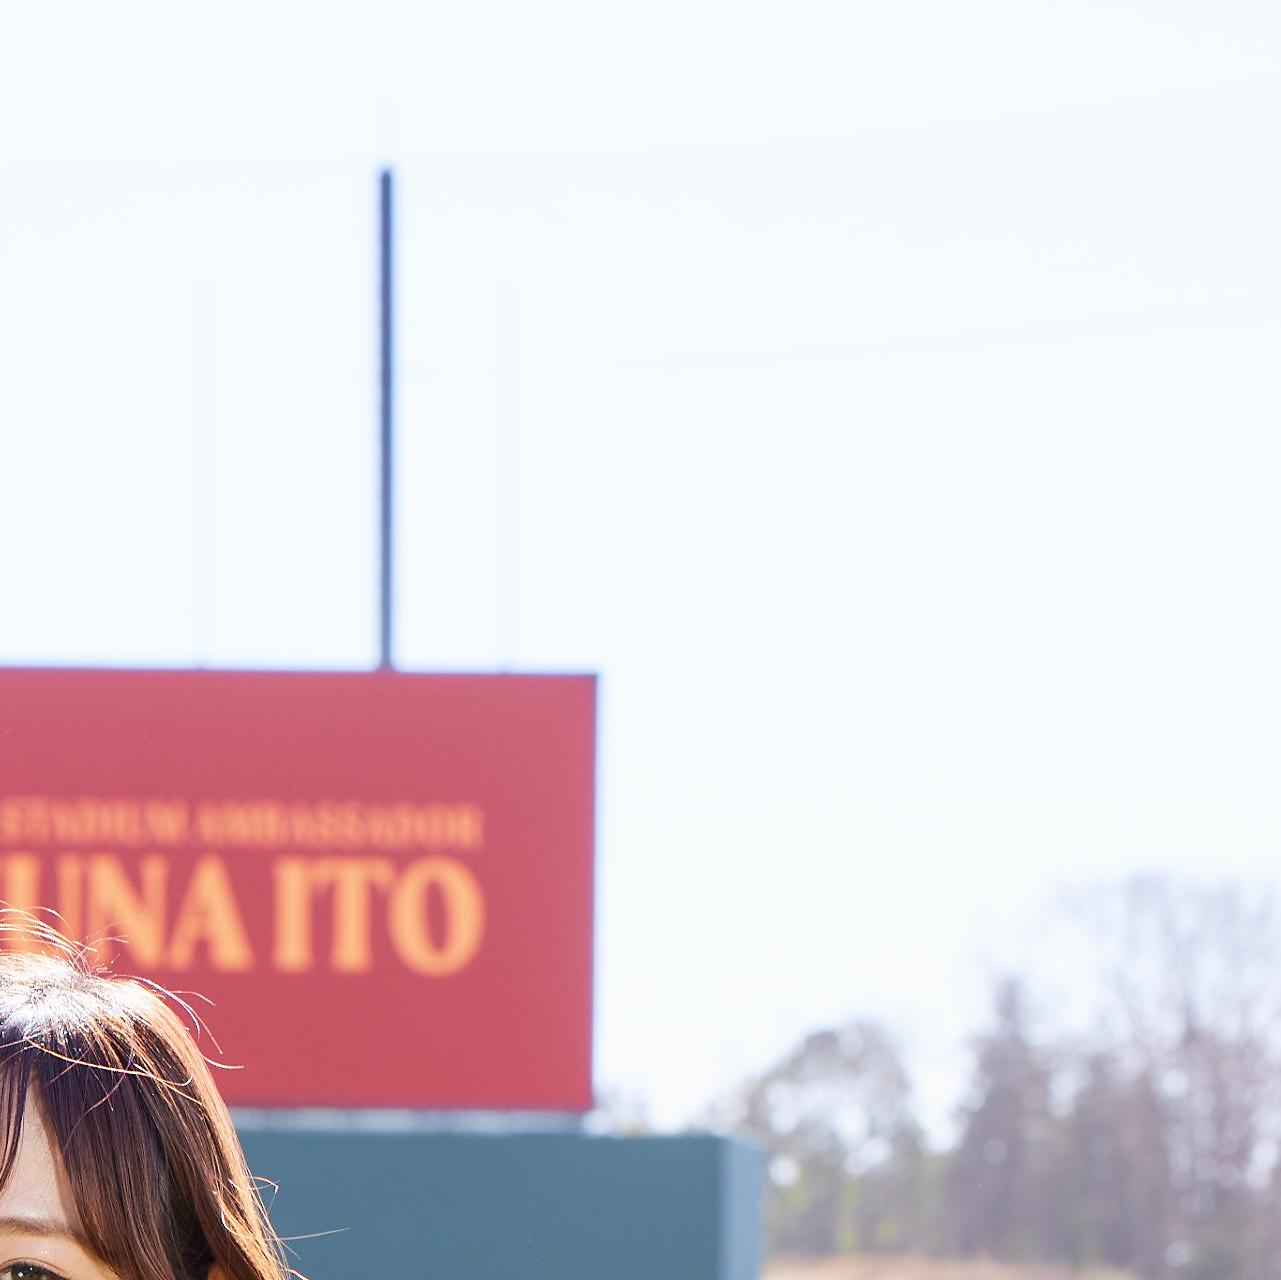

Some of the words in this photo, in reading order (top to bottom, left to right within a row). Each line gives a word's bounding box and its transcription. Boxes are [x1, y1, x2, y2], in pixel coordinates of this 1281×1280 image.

[0, 796, 187, 847] STADIUM
[197, 799, 485, 851] AMBASSADOR
[273, 855, 488, 976] ITO
